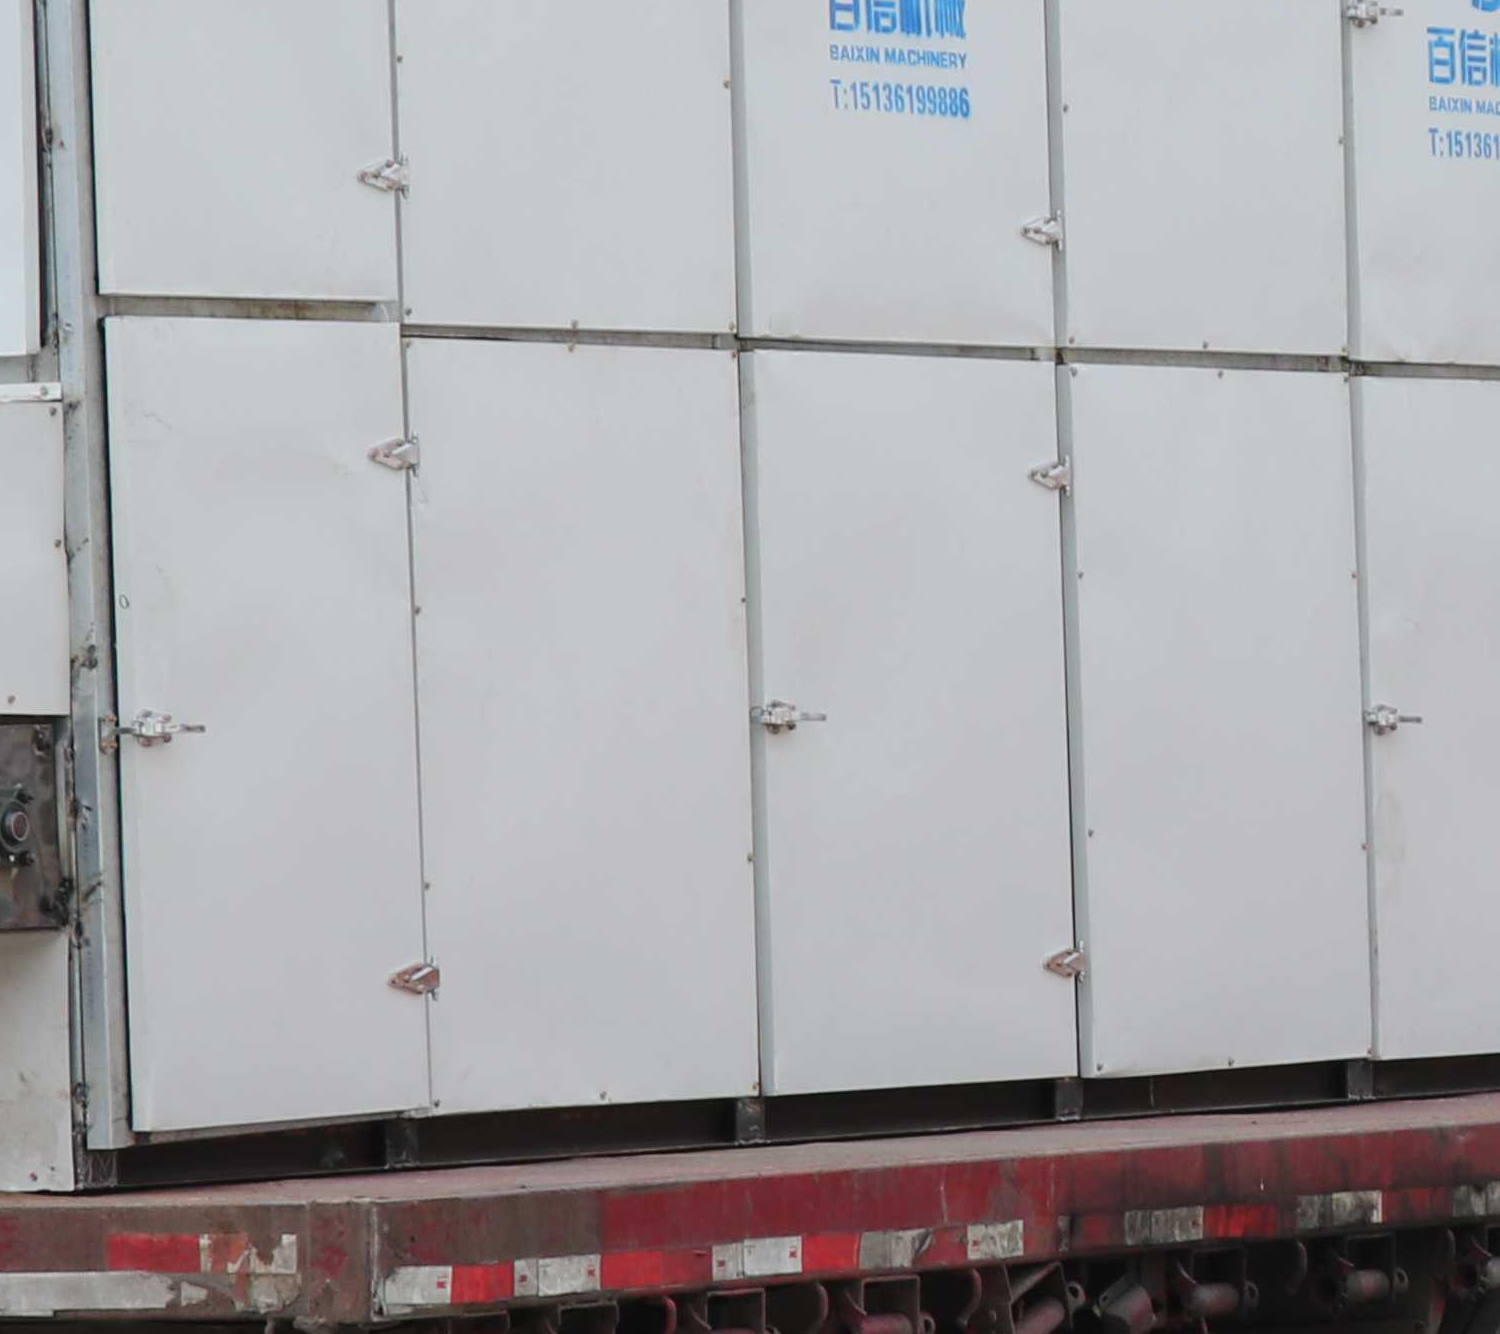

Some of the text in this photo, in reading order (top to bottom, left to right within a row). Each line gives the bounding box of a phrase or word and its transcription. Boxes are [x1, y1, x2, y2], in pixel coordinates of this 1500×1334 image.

[830, 44, 967, 69] BAIXIN MACHINERY
[830, 78, 971, 118] T:15136199886
[1428, 95, 1472, 113] BAIXIN
